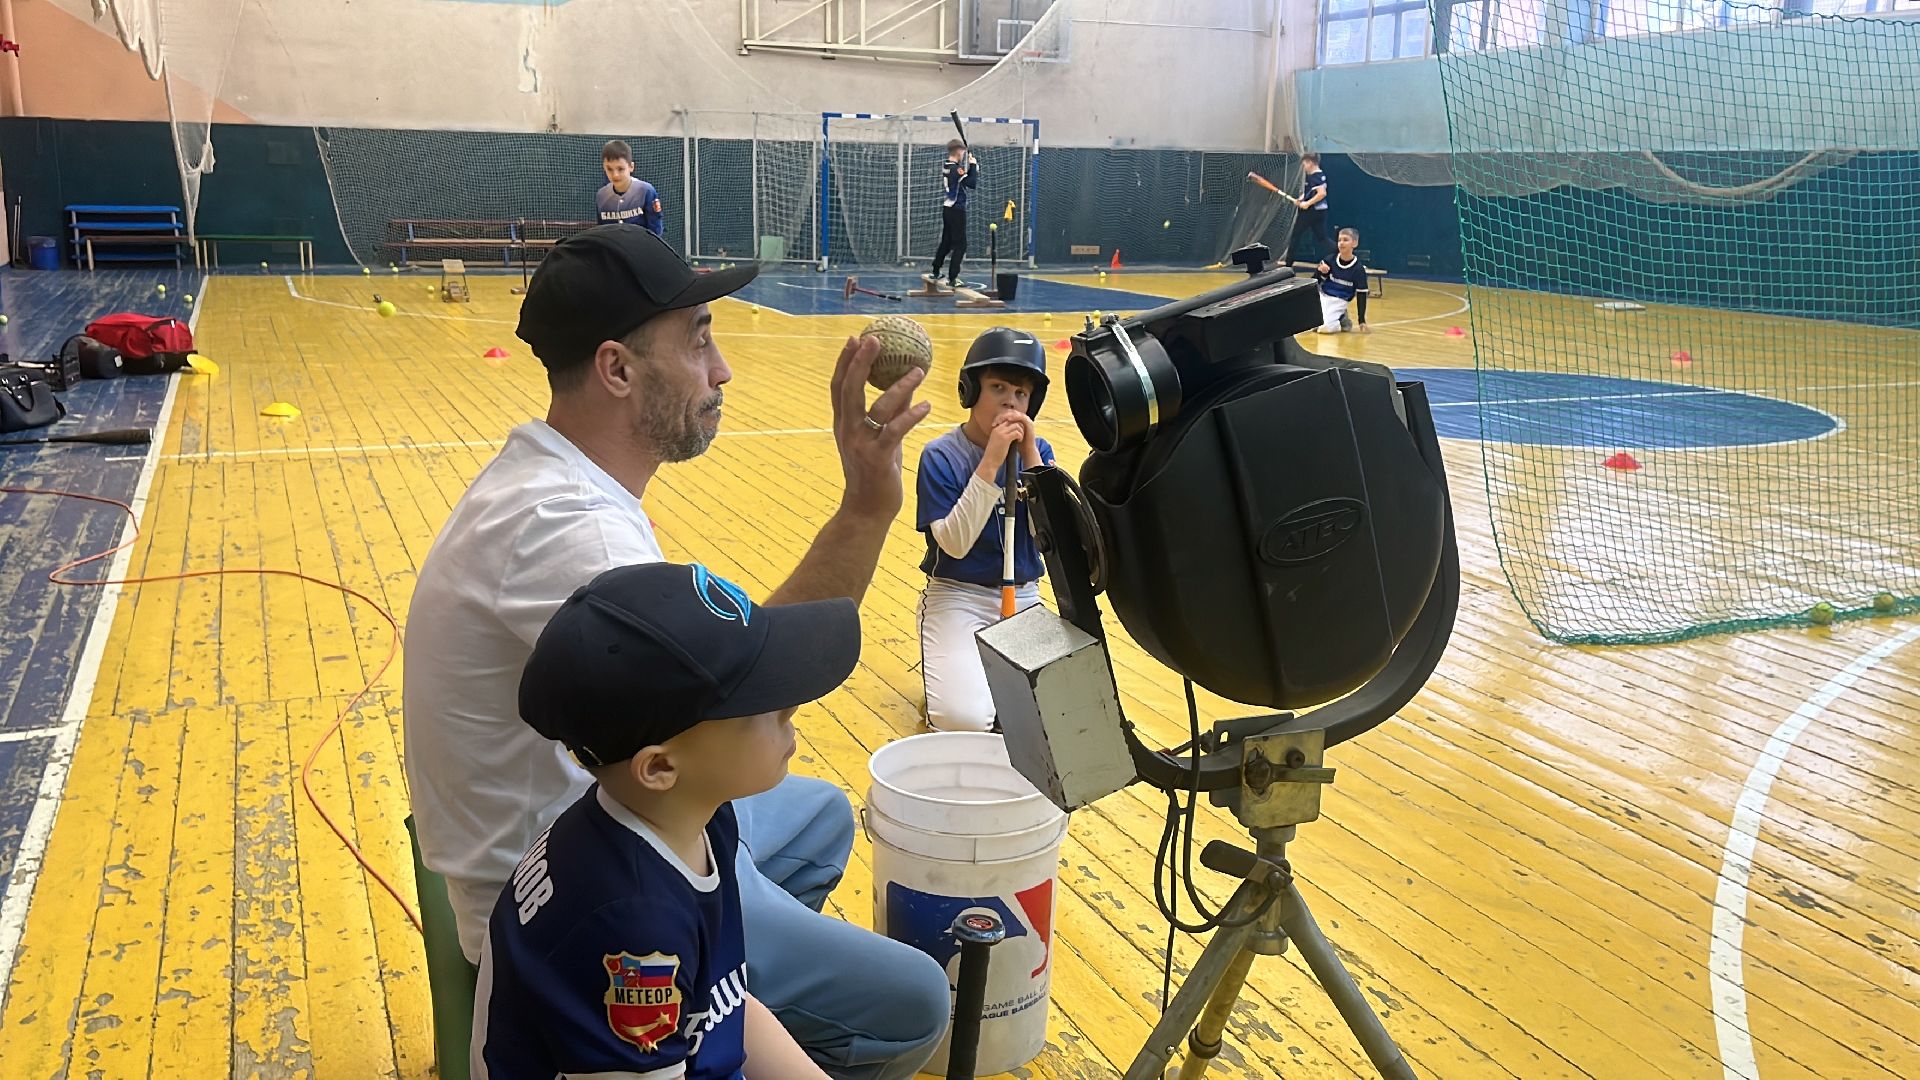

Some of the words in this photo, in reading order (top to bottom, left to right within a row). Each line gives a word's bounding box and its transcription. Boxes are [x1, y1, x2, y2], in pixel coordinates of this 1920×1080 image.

[601, 207, 643, 220] БАЛАШИХА
[513, 821, 554, 925] НОВ
[615, 987, 673, 1004] МЕТЕОР
[983, 1000, 1015, 1012] GAME
[1017, 989, 1037, 1004] BALL
[979, 1010, 1010, 1021] AGUE
